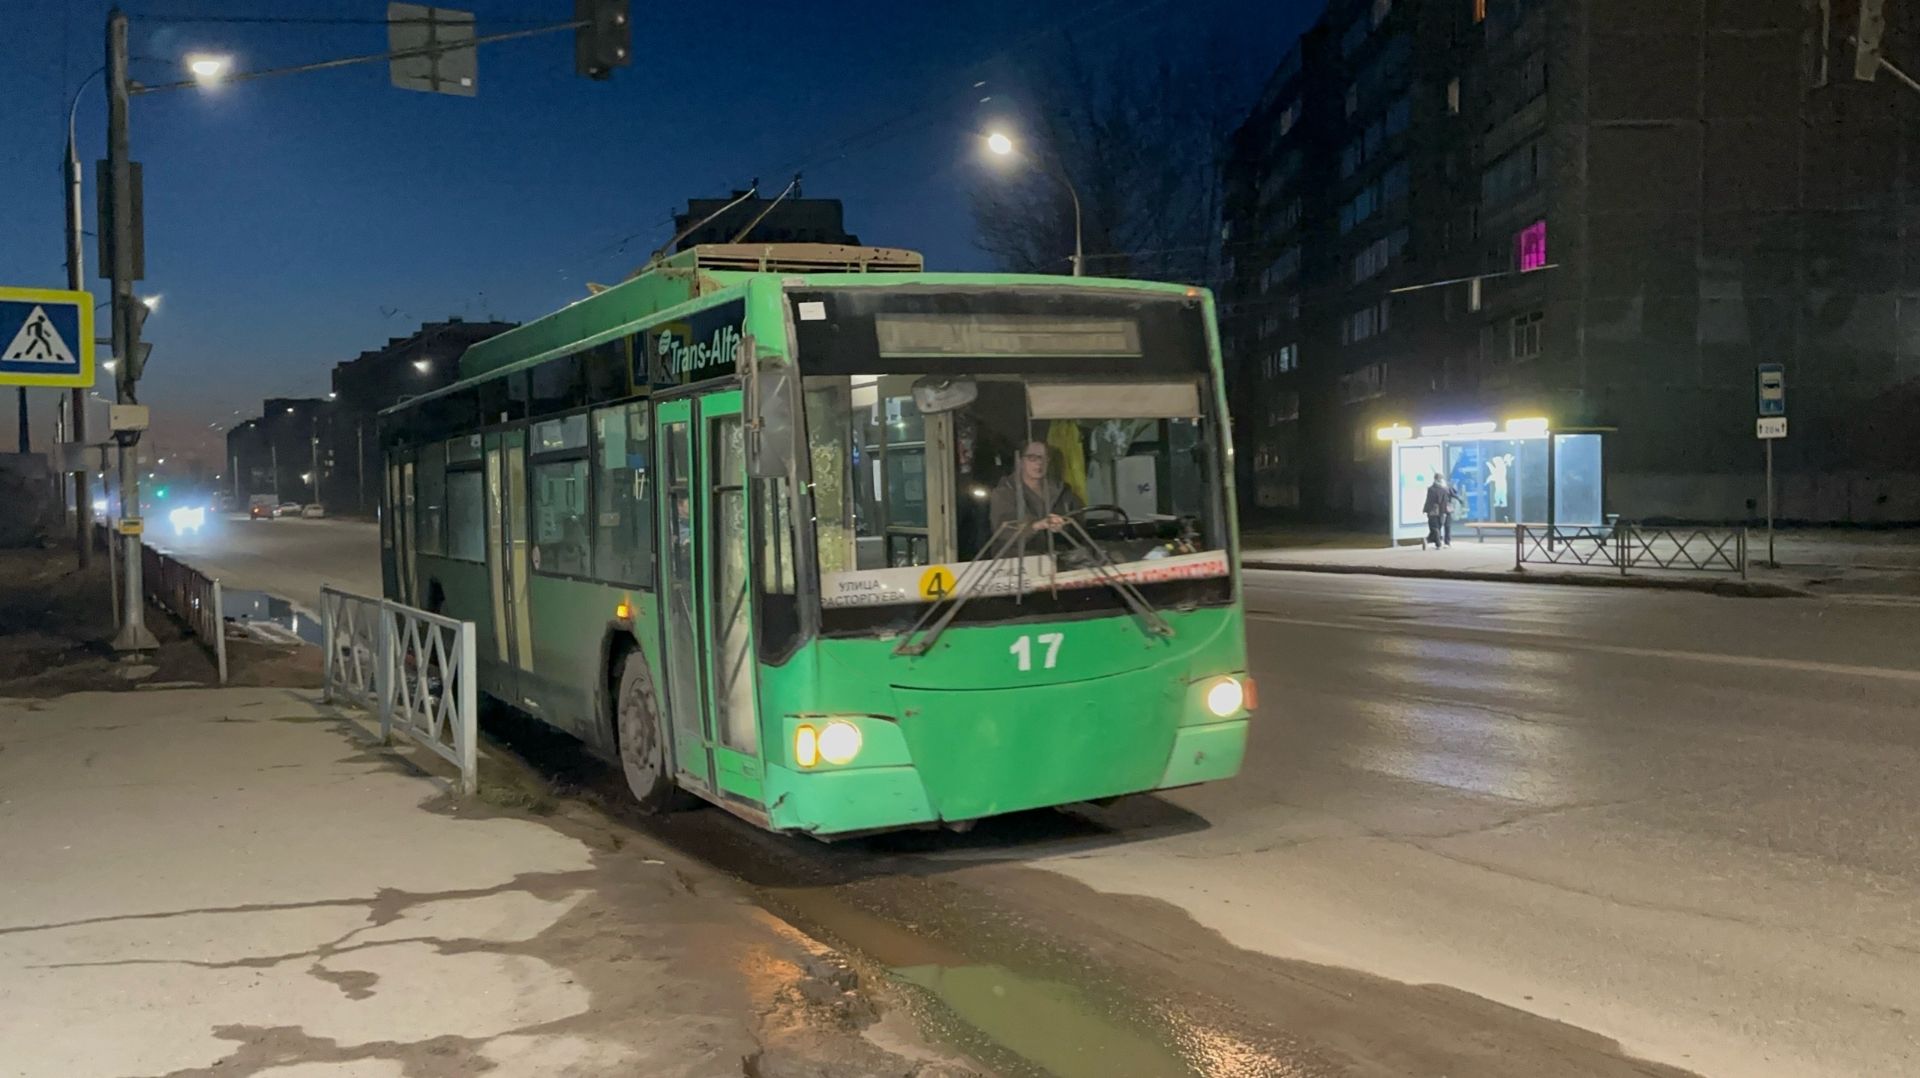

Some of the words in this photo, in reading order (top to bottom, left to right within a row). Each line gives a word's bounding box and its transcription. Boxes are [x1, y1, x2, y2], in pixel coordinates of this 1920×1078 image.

[671, 325, 740, 374] Trans-Alfa
[838, 580, 880, 592] УЛИЦА
[927, 572, 946, 598] 4
[820, 591, 907, 607] РАСТОРГУЕВА
[1009, 632, 1065, 671] 17
